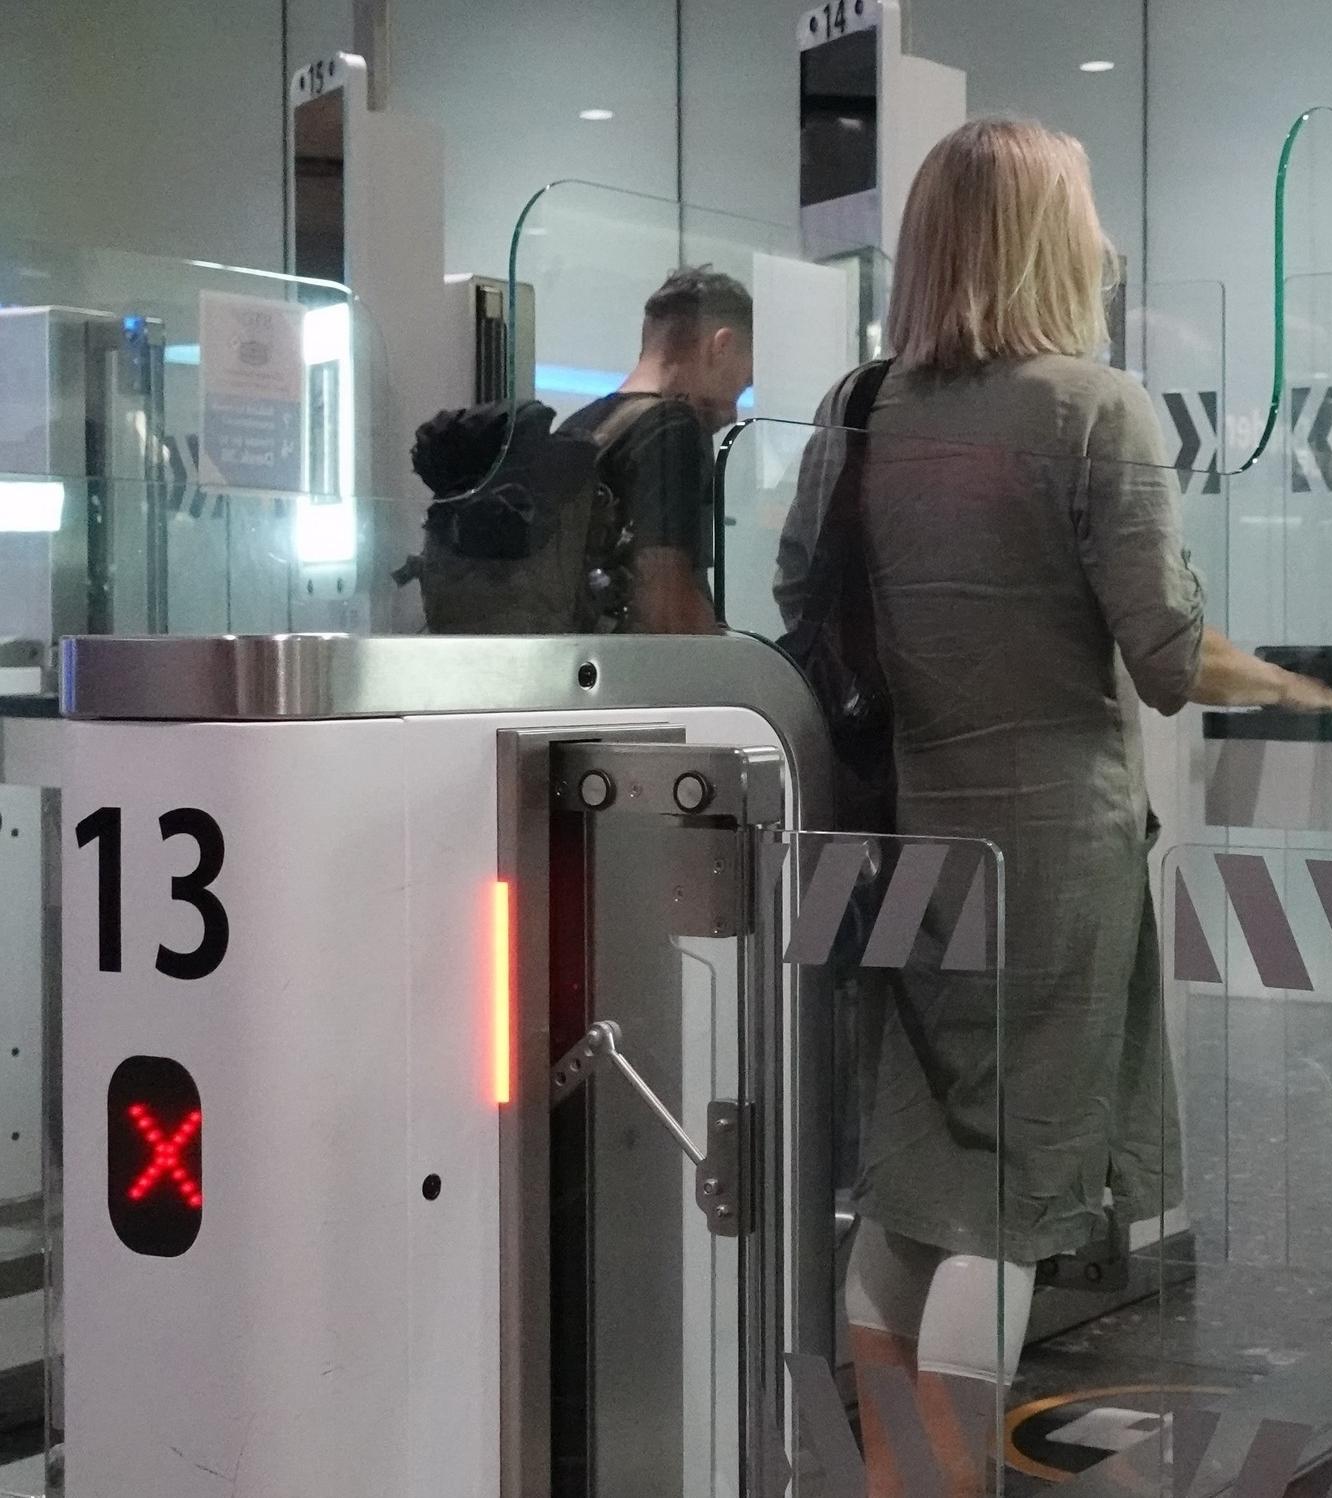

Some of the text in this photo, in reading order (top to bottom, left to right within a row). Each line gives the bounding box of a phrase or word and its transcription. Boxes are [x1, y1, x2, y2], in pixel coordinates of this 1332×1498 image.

[824, 0, 846, 38] 14
[309, 61, 323, 94] 15
[75, 807, 229, 980] 13
